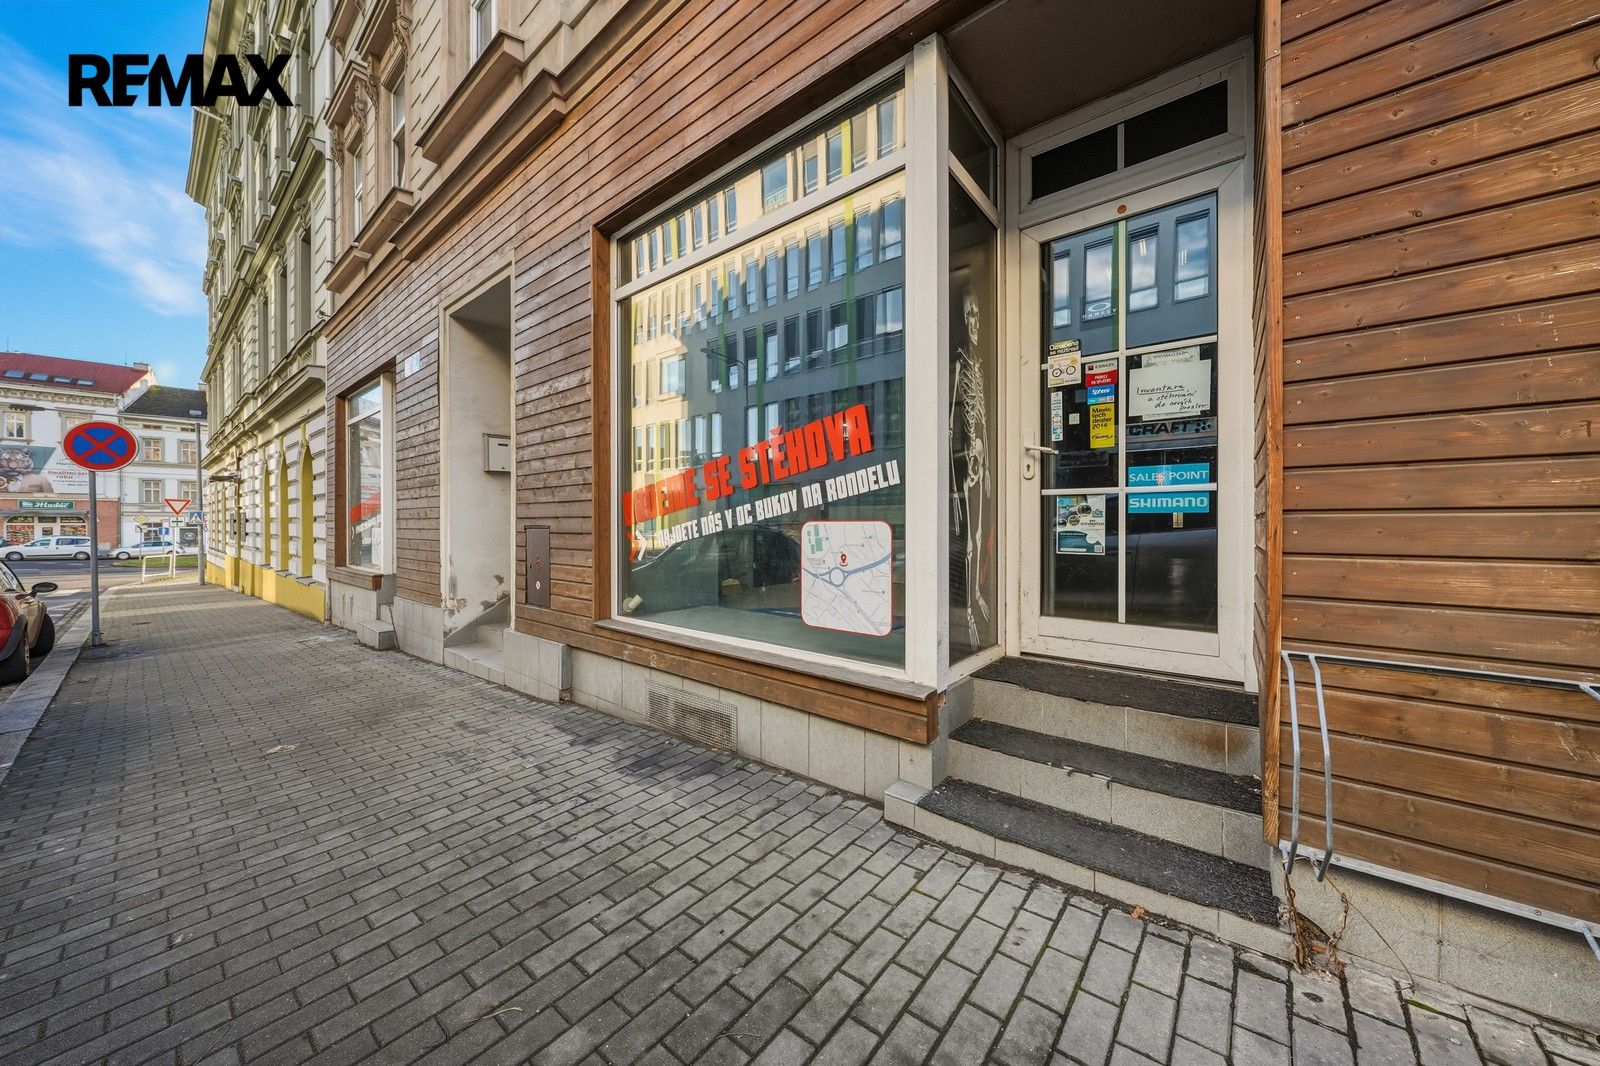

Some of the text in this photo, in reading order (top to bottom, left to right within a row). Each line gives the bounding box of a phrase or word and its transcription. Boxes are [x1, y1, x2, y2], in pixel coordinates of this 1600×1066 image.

[703, 454, 736, 502] SE
[738, 403, 874, 491] STĚHOVA
[700, 510, 723, 536] NÁS
[724, 508, 733, 529] V
[755, 489, 799, 521] BUKOV
[802, 482, 823, 509] NA
[825, 459, 901, 504] RONDELU
[1129, 470, 1209, 483] SALES POINT
[1129, 497, 1208, 508] SHIMANO
